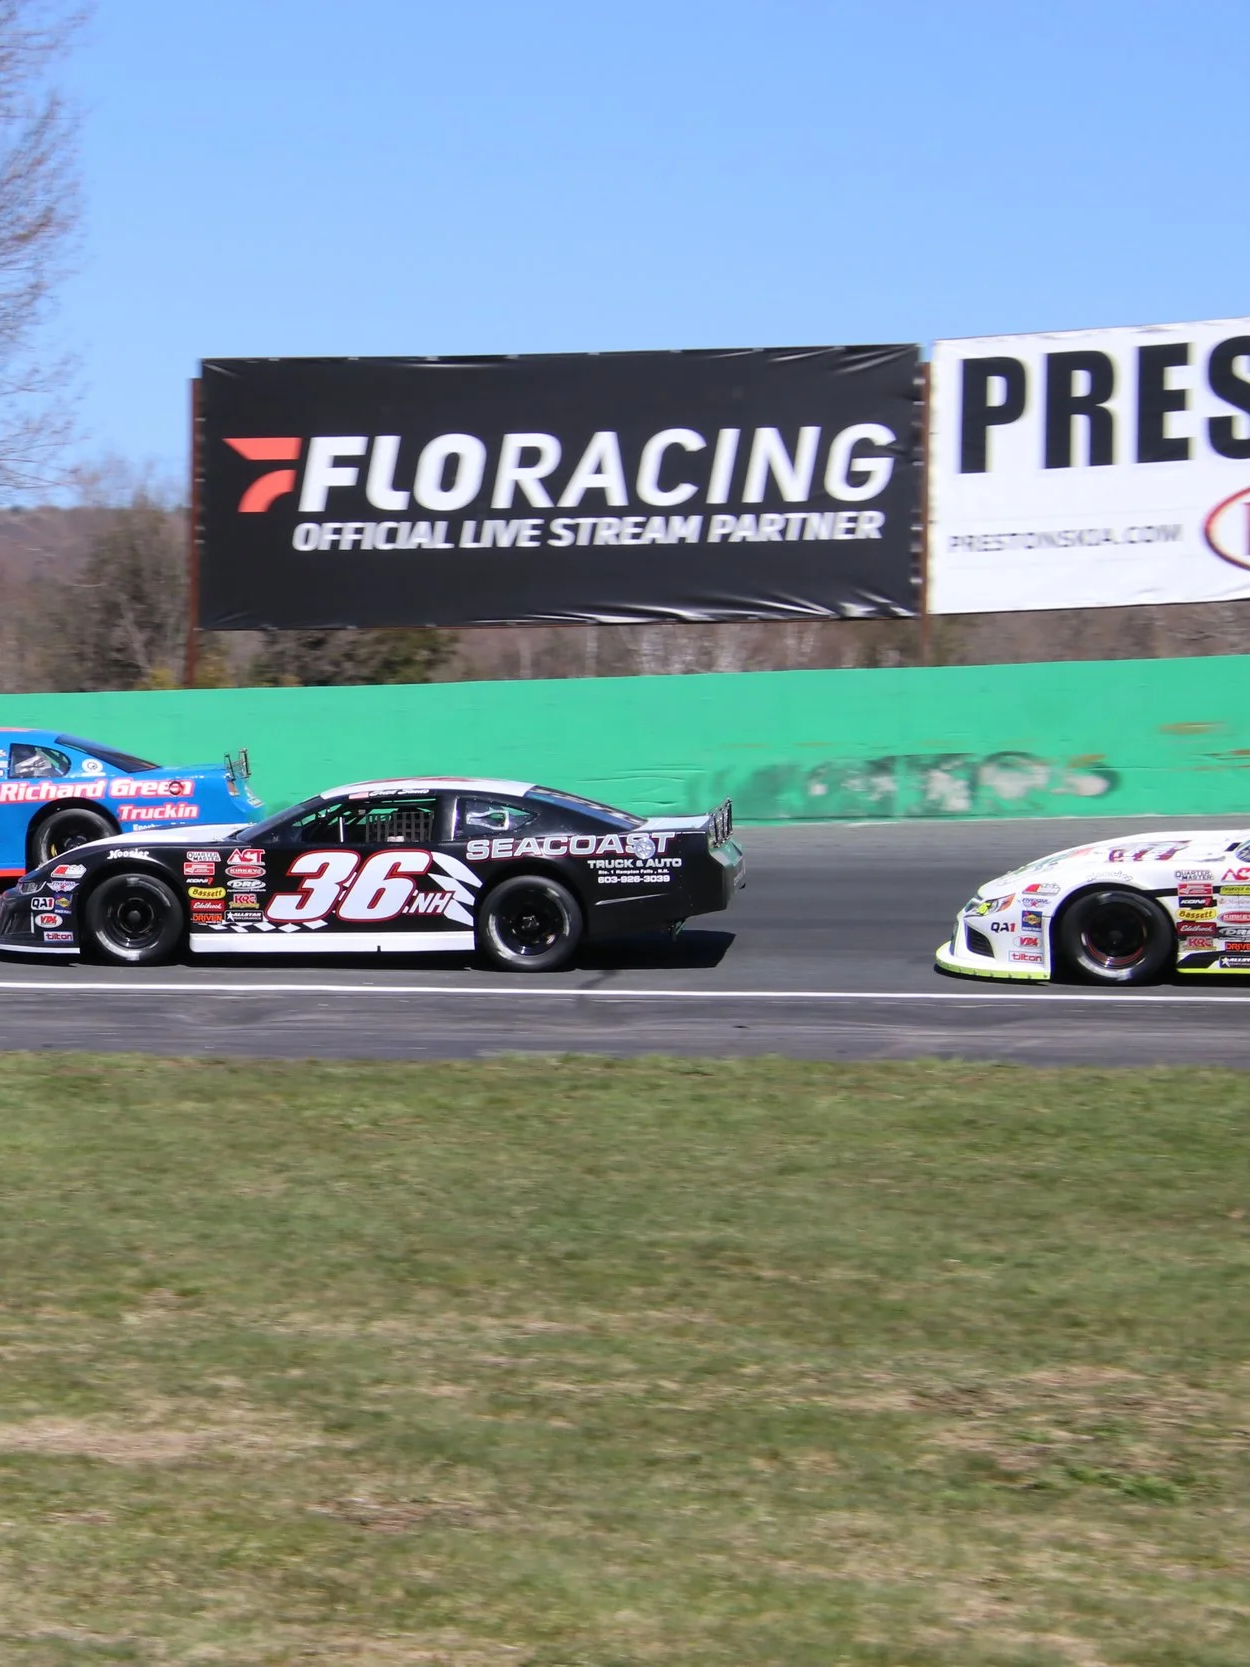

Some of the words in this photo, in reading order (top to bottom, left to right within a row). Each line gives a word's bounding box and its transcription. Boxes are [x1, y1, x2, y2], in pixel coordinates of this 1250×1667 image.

[299, 423, 897, 512] FLORACING
[293, 521, 453, 551] OFFICIAL
[459, 519, 541, 548] LIVE
[547, 515, 703, 546] STREAM
[707, 511, 884, 543] PARTNER
[0, 780, 105, 802] Richard
[119, 803, 199, 820] Truckin
[466, 832, 675, 860] SEACOAST
[107, 848, 149, 859] Hoosier
[228, 849, 264, 862] ACT
[587, 859, 634, 868] TRUCK
[645, 858, 682, 867] AUTO
[598, 875, 670, 883] 603-926-3039
[267, 851, 432, 920] 36
[193, 889, 222, 897] Bassett
[32, 899, 53, 908] QA1
[1179, 911, 1212, 919] Bassett
[991, 922, 1016, 933] QA1
[1012, 953, 1042, 962] tilton
